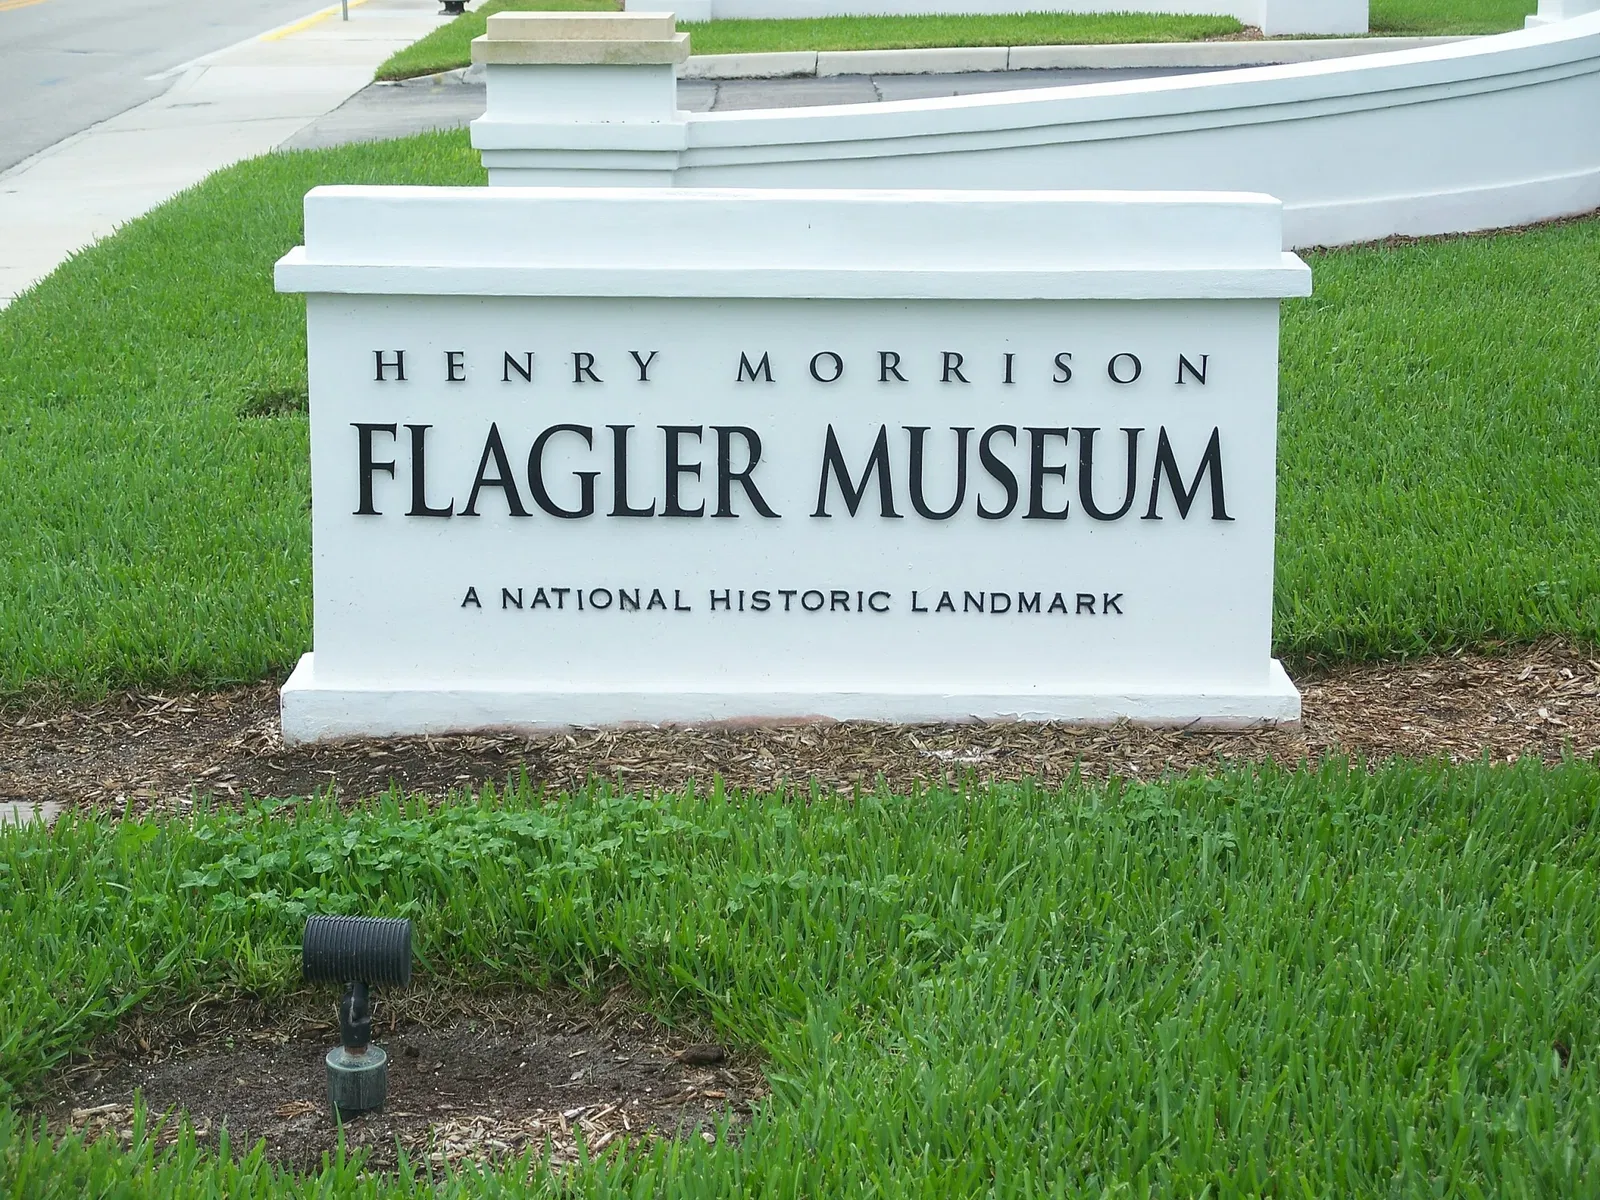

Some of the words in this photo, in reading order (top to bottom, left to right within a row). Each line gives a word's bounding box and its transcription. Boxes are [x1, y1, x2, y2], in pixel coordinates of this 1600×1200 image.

[372, 350, 659, 383] HENRY
[736, 351, 1210, 386] MORRISON
[349, 421, 782, 520] FLAGLER
[809, 423, 1236, 522] MUSEUM
[460, 586, 482, 609] A
[501, 587, 692, 612] NATIONAL
[709, 588, 892, 613] HISTORIC
[911, 590, 1124, 615] LANDMARK
